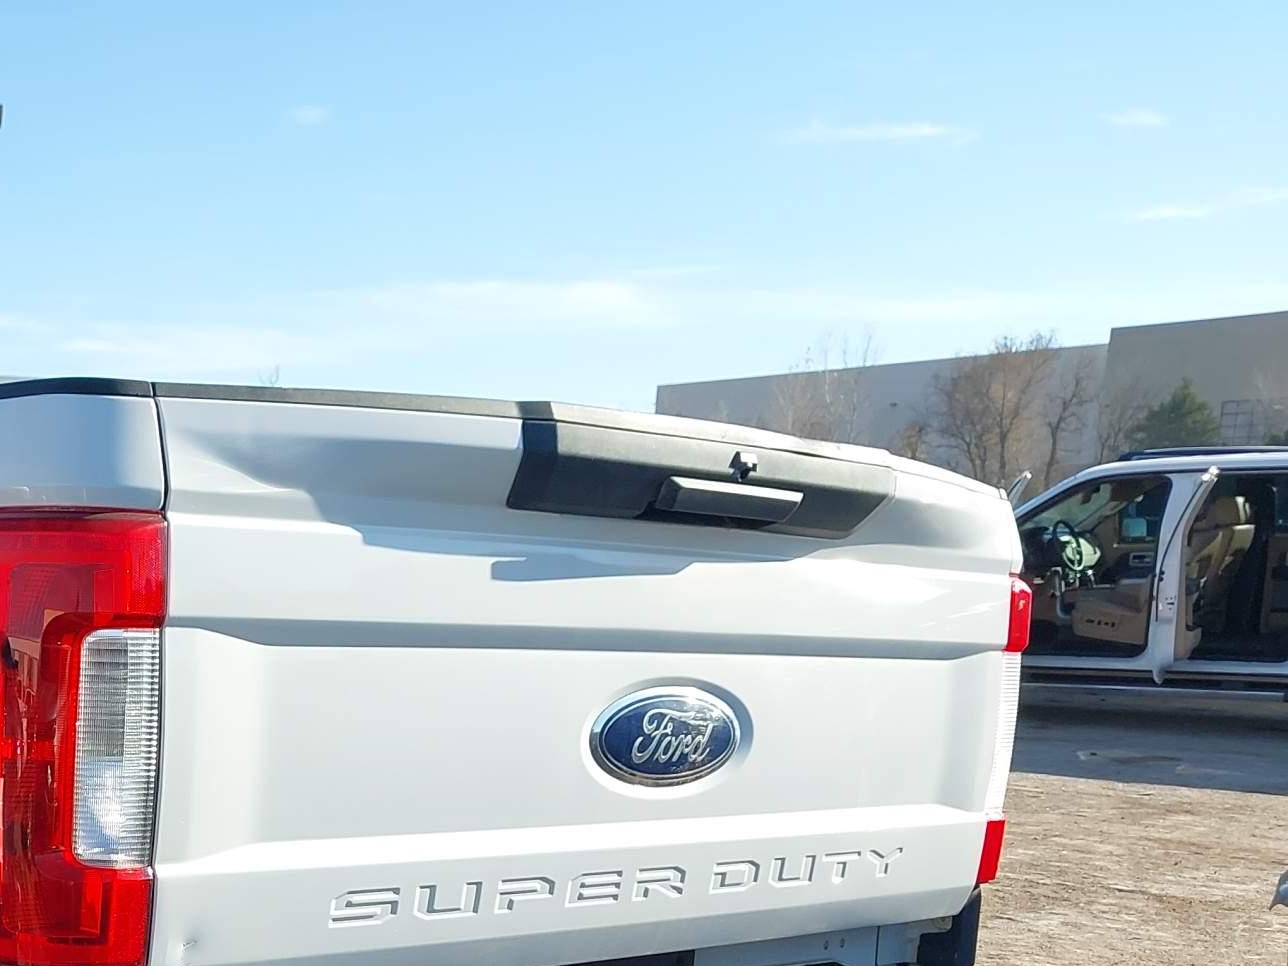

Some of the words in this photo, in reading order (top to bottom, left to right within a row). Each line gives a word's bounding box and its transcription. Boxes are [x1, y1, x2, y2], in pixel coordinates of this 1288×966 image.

[631, 708, 715, 764] Ford
[328, 865, 687, 928] SUPER
[709, 847, 904, 895] DUTY
